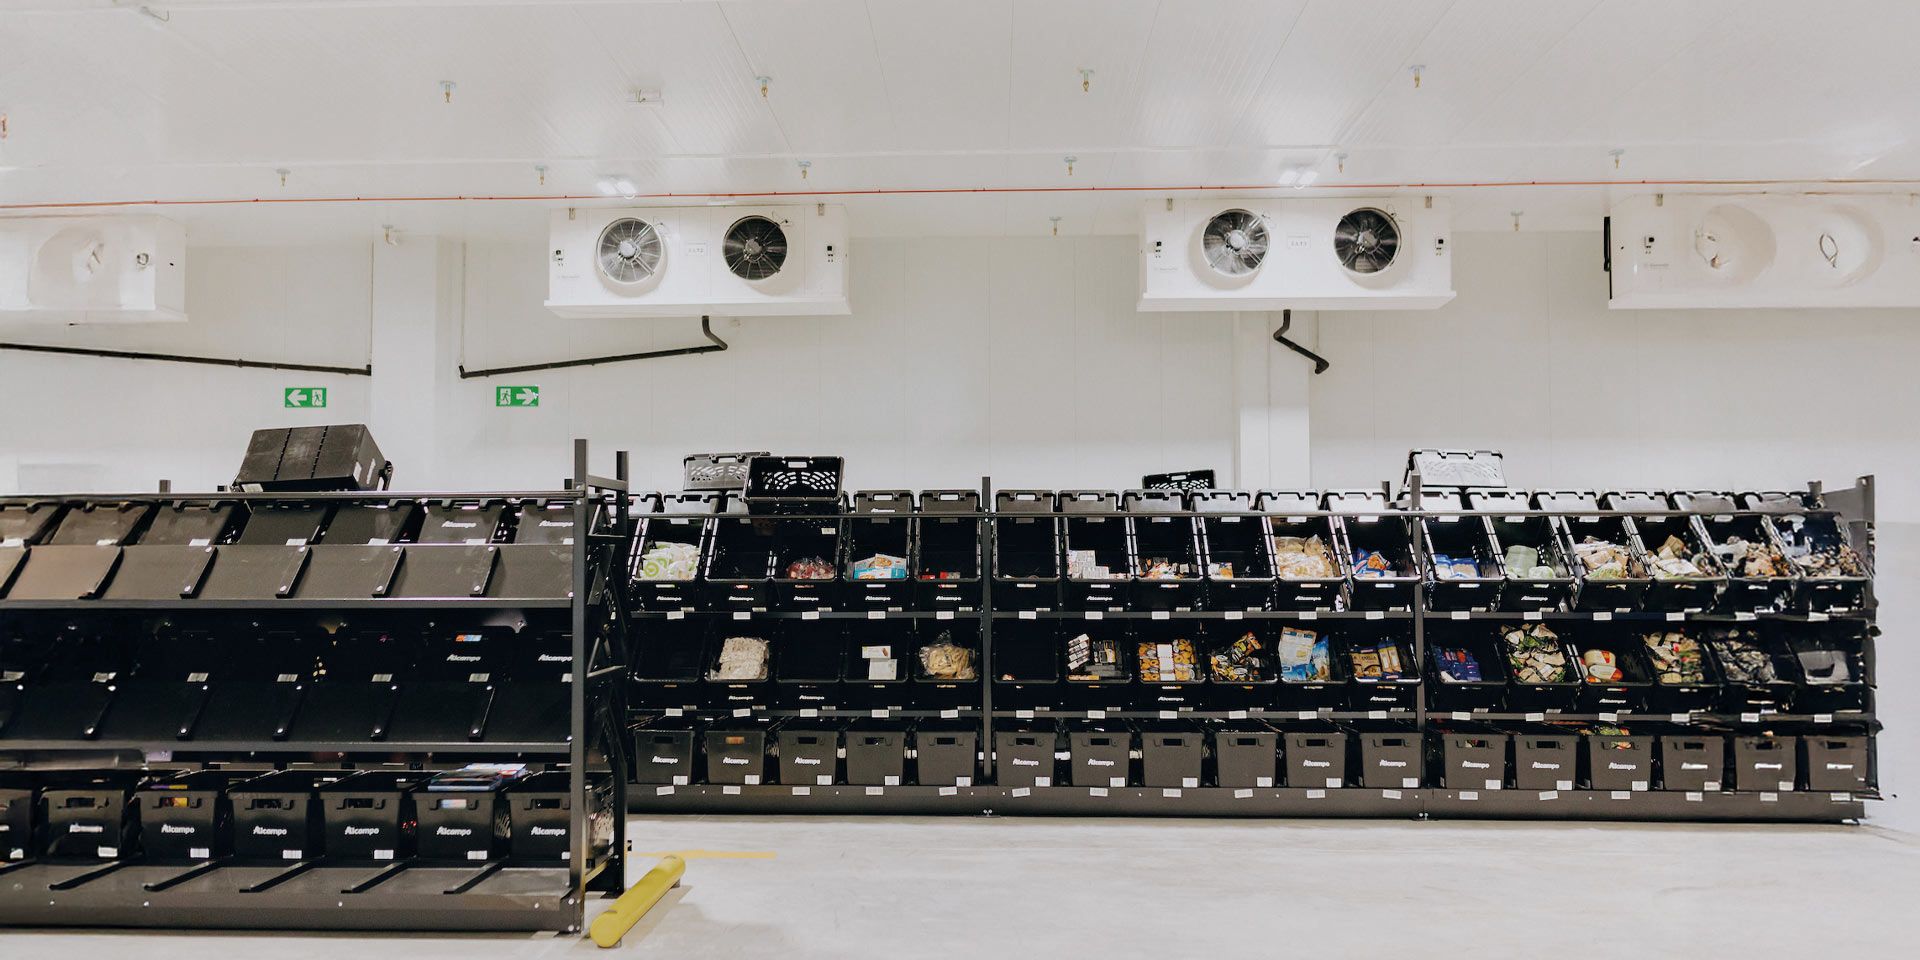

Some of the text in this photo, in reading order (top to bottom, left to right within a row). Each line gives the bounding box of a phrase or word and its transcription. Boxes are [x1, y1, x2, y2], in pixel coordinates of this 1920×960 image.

[161, 824, 195, 834] Alcampo
[253, 826, 287, 836] Alcampo
[345, 826, 379, 835] Alcampo
[437, 826, 471, 836] Alcampo
[531, 826, 566, 836] Alcampo
